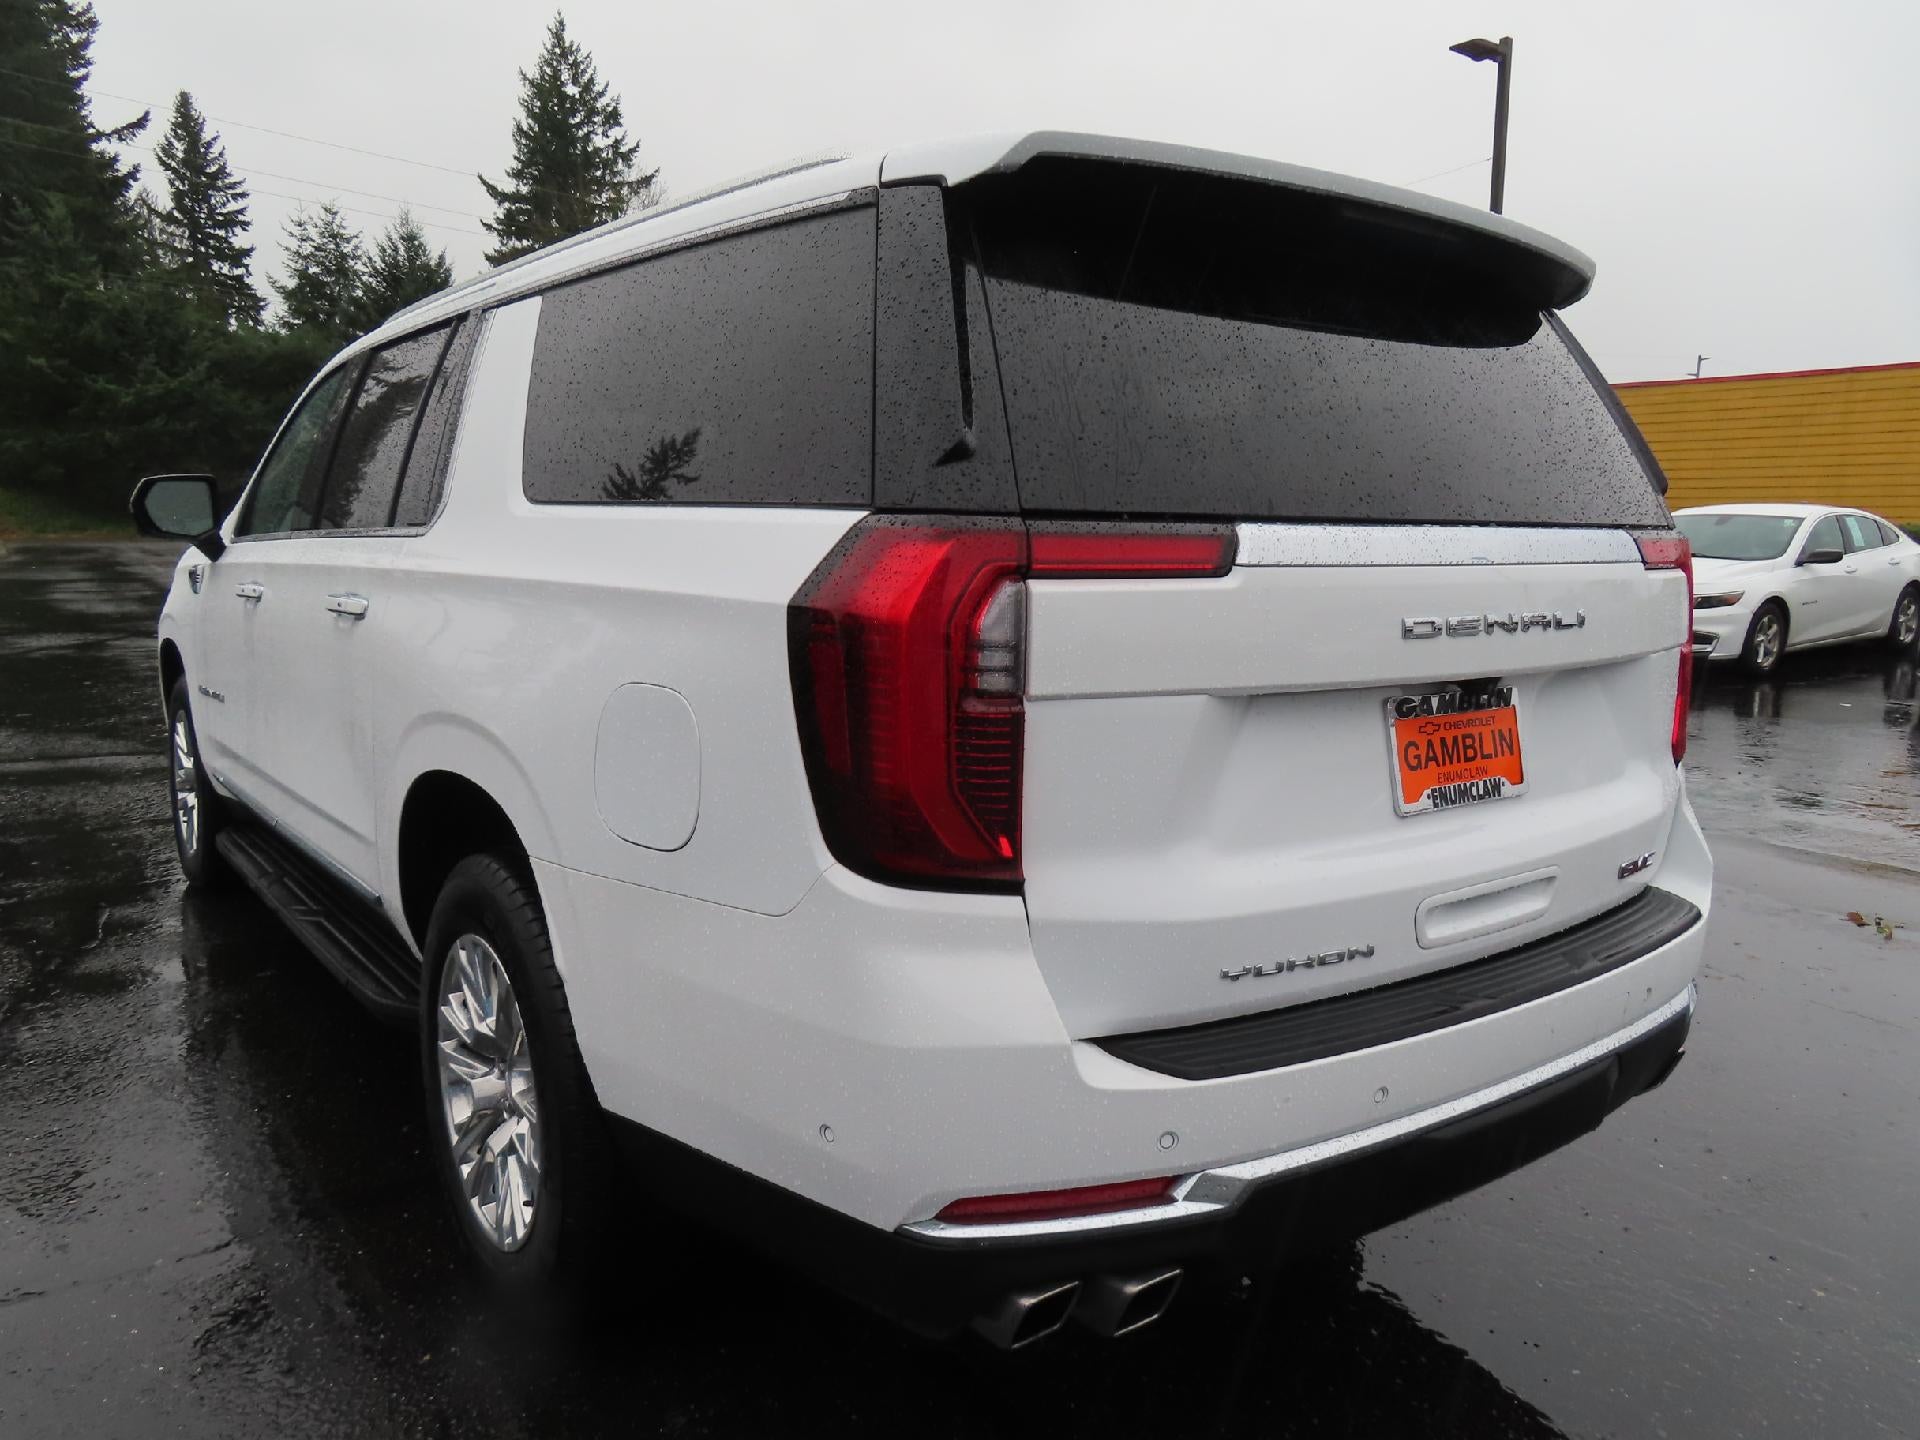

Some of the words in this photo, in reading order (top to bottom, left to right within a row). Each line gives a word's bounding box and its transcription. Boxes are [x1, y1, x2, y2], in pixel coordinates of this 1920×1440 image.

[1401, 608, 1586, 640] DENALI
[1443, 716, 1496, 731] CHEVROLET
[1403, 727, 1515, 772] GAMBLIN
[1437, 766, 1489, 784] ENUMCLAW
[1430, 777, 1502, 809] ENUMCLAW
[1220, 944, 1375, 981] YUKON
